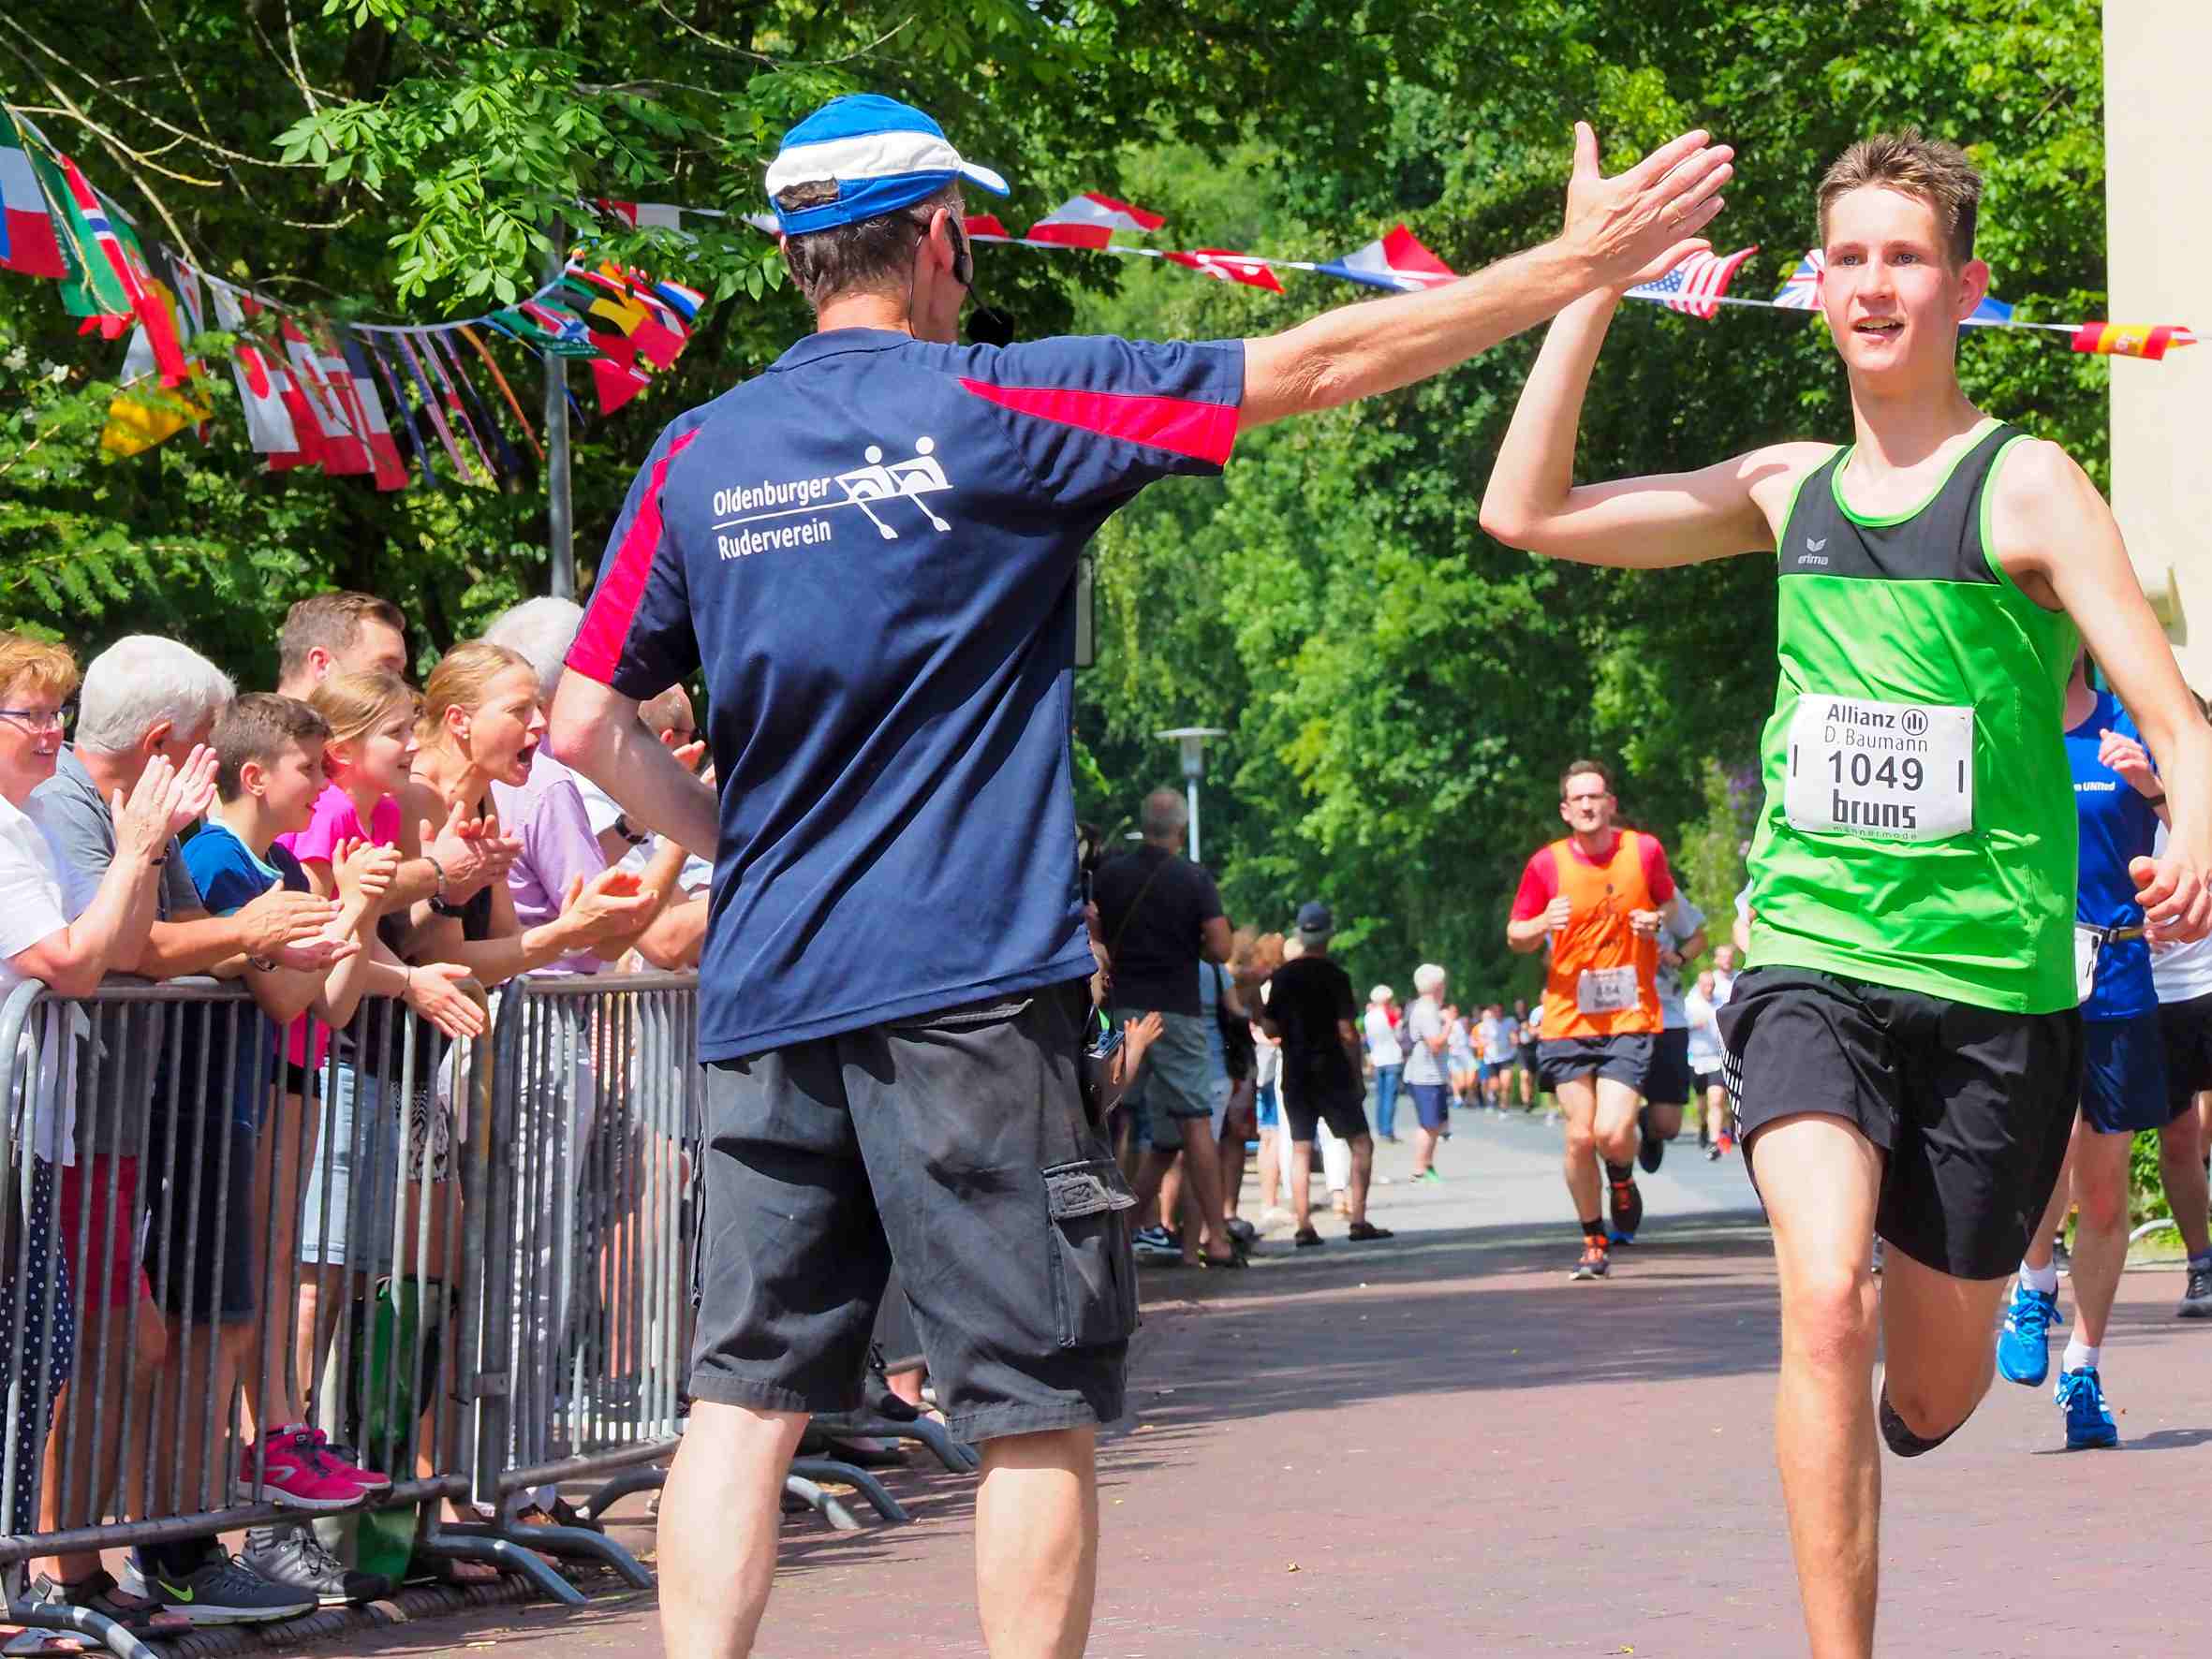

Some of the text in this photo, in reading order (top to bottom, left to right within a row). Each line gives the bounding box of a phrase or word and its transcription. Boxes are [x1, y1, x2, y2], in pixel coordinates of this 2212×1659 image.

[713, 477, 831, 516] Oldenburger
[717, 519, 832, 560] Ruderverein
[1798, 553, 1828, 565] erima
[1827, 703, 1895, 728] Allianz
[1846, 728, 1927, 753] Baumann
[1828, 750, 1924, 791] 1049
[1833, 788, 1917, 830] bruns
